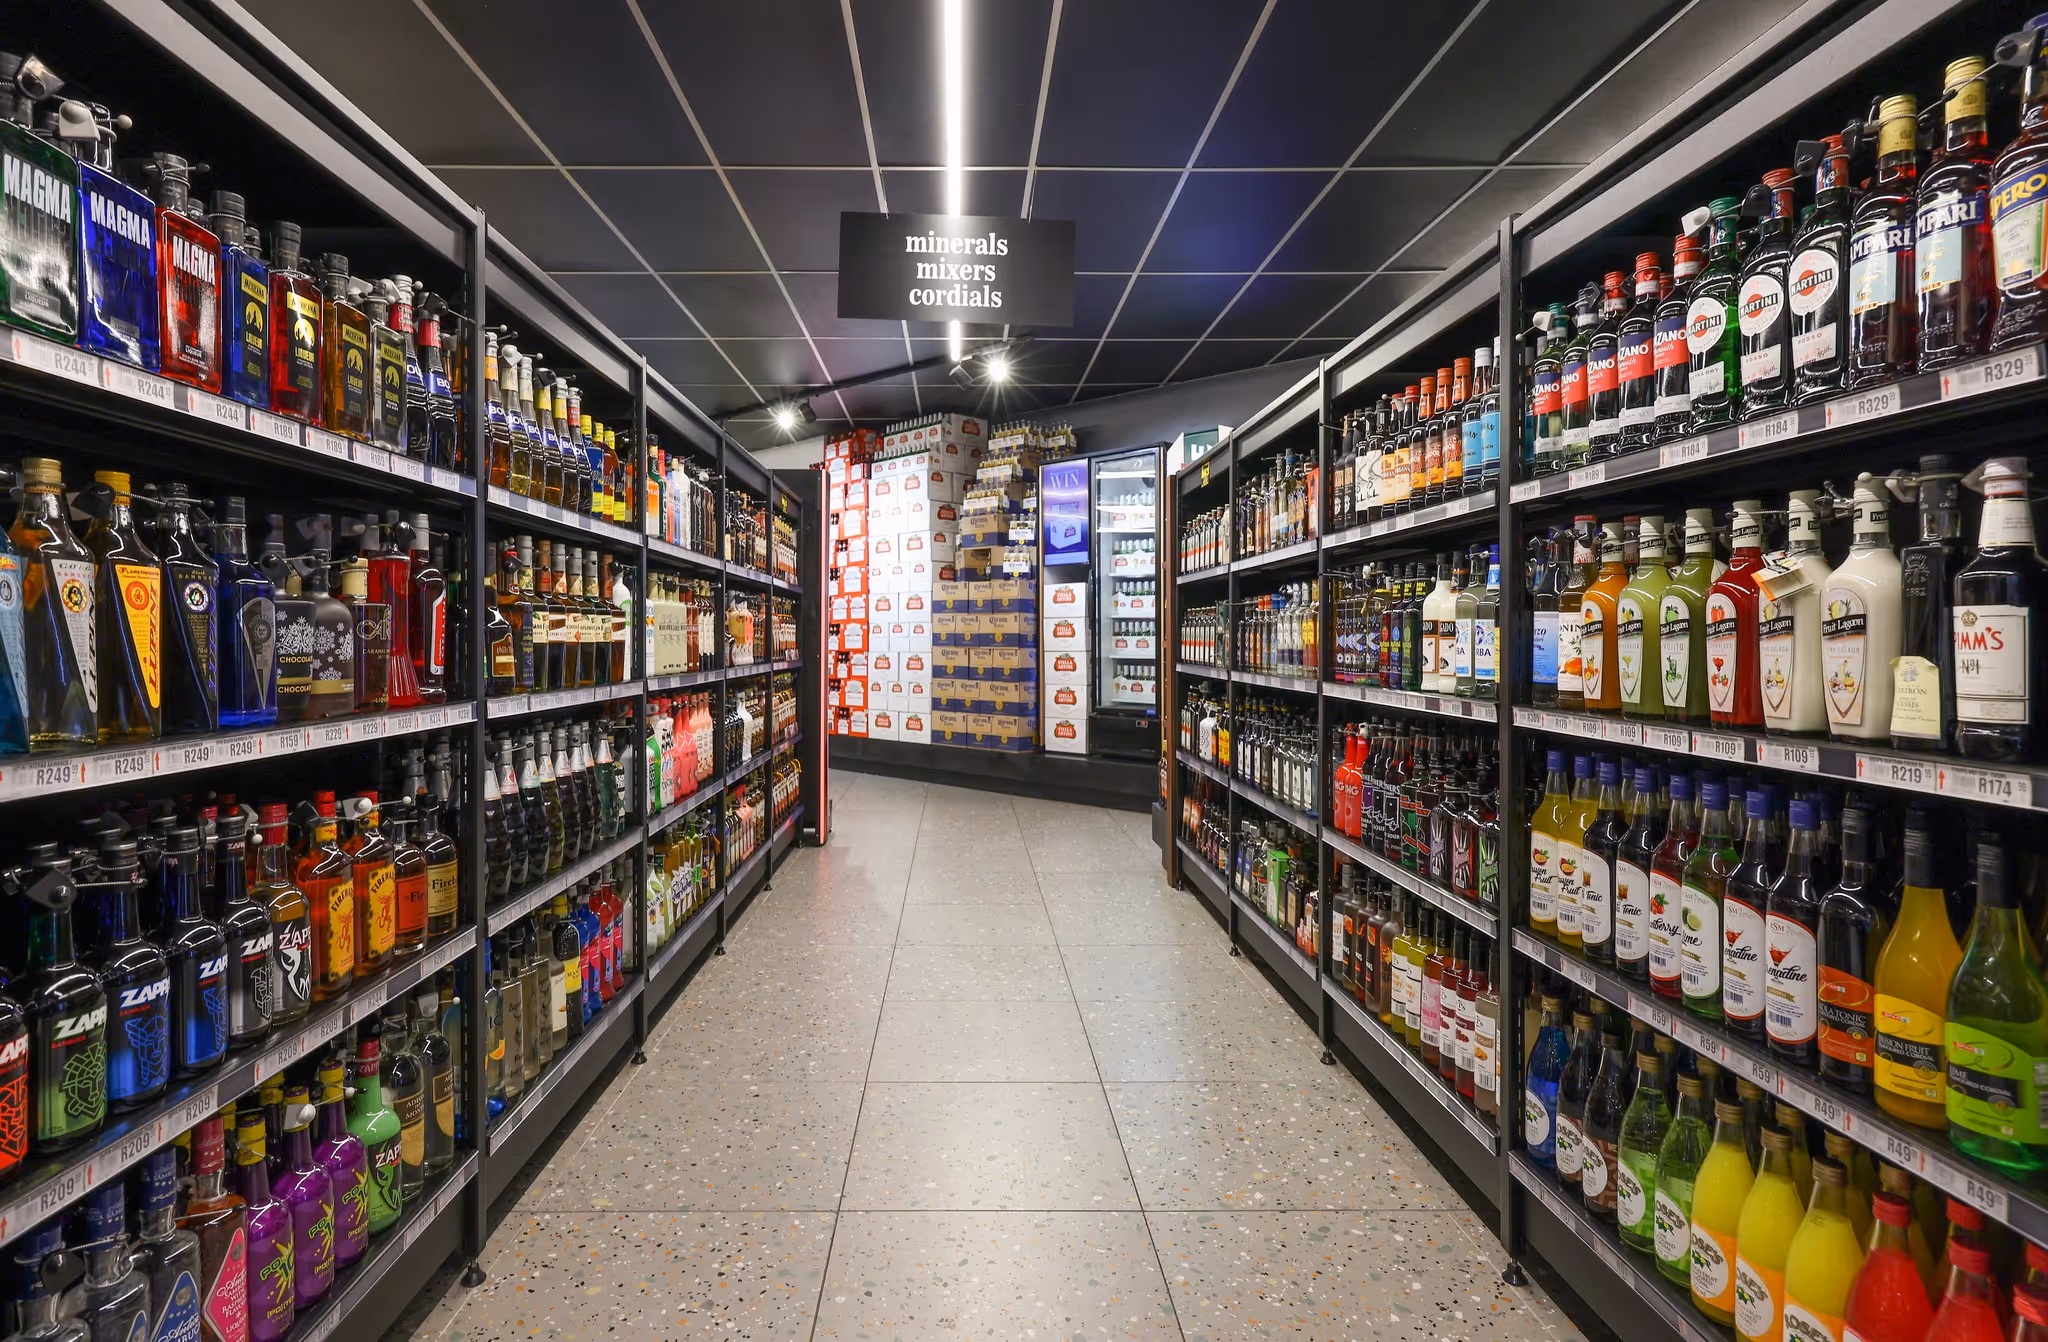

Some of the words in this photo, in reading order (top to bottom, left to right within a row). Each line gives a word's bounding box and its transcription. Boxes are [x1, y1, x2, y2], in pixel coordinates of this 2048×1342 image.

[4, 154, 71, 223] MAGMA
[1990, 173, 2047, 219] PERO
[90, 191, 151, 249] MAGMA
[1915, 202, 1977, 234] MPARI
[906, 230, 1008, 256] minerals
[1851, 224, 1912, 261] MPARI
[173, 236, 216, 286] MAGMA
[916, 257, 996, 282] mixers
[1791, 268, 1833, 296] MARTINI
[909, 284, 1002, 308] cordials
[1740, 293, 1778, 318] MARTINI
[1654, 327, 1688, 345] ZANO
[1797, 332, 1822, 345] ROSSO
[1618, 343, 1650, 361] ZANO
[54, 351, 88, 377] R244
[1588, 357, 1615, 374] ZANO
[1984, 358, 2024, 384] R329
[137, 378, 165, 400] R244
[1532, 383, 1560, 396] ZANO
[216, 403, 239, 423] R244
[1858, 394, 1889, 414] R329
[273, 422, 293, 440] R189
[1765, 416, 1788, 434] R184
[326, 438, 343, 455] R189
[1681, 443, 1700, 459] R184
[1051, 471, 1080, 489] WIN
[1558, 623, 1582, 634] ONIN
[1837, 616, 1865, 632] Lagoon
[325, 729, 342, 741] R229
[362, 722, 378, 735] R229
[1582, 722, 1597, 733] R109
[1620, 725, 1636, 737] R109
[230, 741, 253, 757] R249
[280, 734, 299, 749] R159
[1663, 734, 1682, 746] R109
[1715, 741, 1736, 756] R109
[184, 747, 210, 764] R249
[1784, 746, 1808, 763] R109
[36, 766, 71, 787] R249
[114, 758, 144, 775] R249
[1891, 765, 1922, 784] R219
[1978, 777, 2012, 797] R174
[410, 890, 425, 902] Fir
[1585, 890, 1604, 903] Tonic
[1621, 903, 1643, 917] Tonic
[1580, 972, 1592, 986] R59
[120, 974, 170, 1008] ZAPP
[54, 1003, 107, 1040] ZAPP
[1652, 1010, 1667, 1027] R59
[1835, 1008, 1867, 1024] TONIC
[320, 1018, 338, 1038] R209
[0, 1032, 29, 1066] APP
[277, 1043, 298, 1065] R209
[1700, 1036, 1717, 1054] R59
[1904, 1042, 1930, 1056] FRUIT
[1752, 1063, 1771, 1084] R59
[185, 1096, 210, 1123] R209
[1525, 1097, 1546, 1119] SE'S
[1814, 1097, 1835, 1119] R49
[1557, 1121, 1582, 1146] OSE'S
[120, 1131, 150, 1163] R209
[1887, 1137, 1912, 1162] R49
[1617, 1170, 1641, 1196] OSE'S
[40, 1177, 75, 1213] R209
[1966, 1180, 1995, 1208] R49
[1655, 1199, 1686, 1230] OSE'S
[1691, 1232, 1723, 1265] OSE'S
[1736, 1268, 1768, 1302] OSE'S
